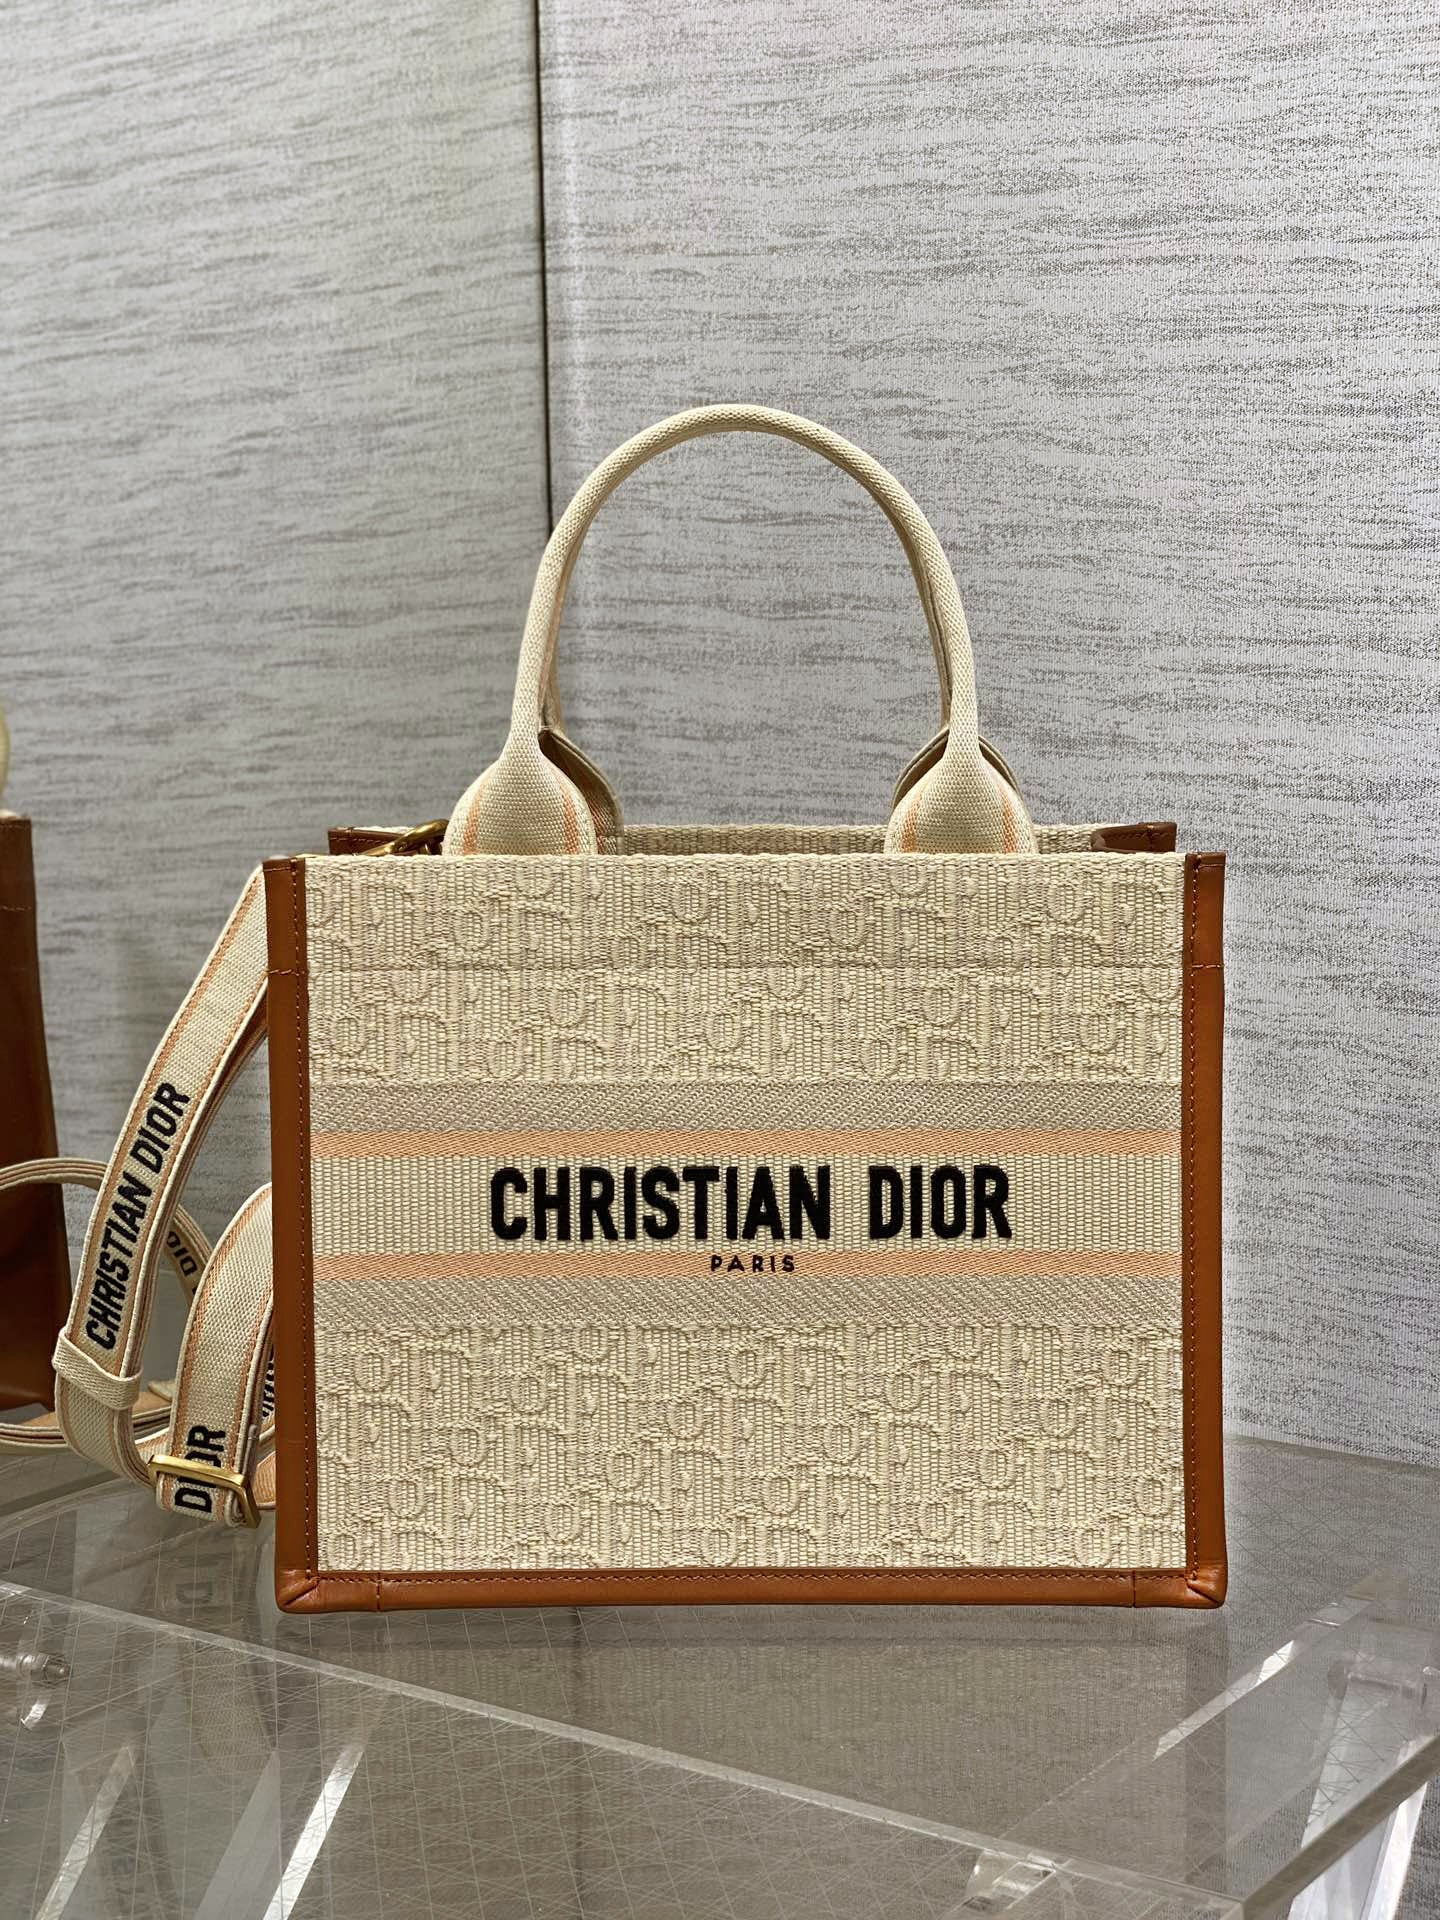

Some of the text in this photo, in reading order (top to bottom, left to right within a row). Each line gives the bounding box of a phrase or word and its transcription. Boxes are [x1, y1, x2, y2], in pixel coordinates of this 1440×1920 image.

[86, 1081, 191, 1350] CHRISTIAN DIOR
[490, 1164, 1013, 1241] CHRISTIAN DIOR
[166, 1231, 197, 1277] DIO
[711, 1254, 795, 1272] PARIS
